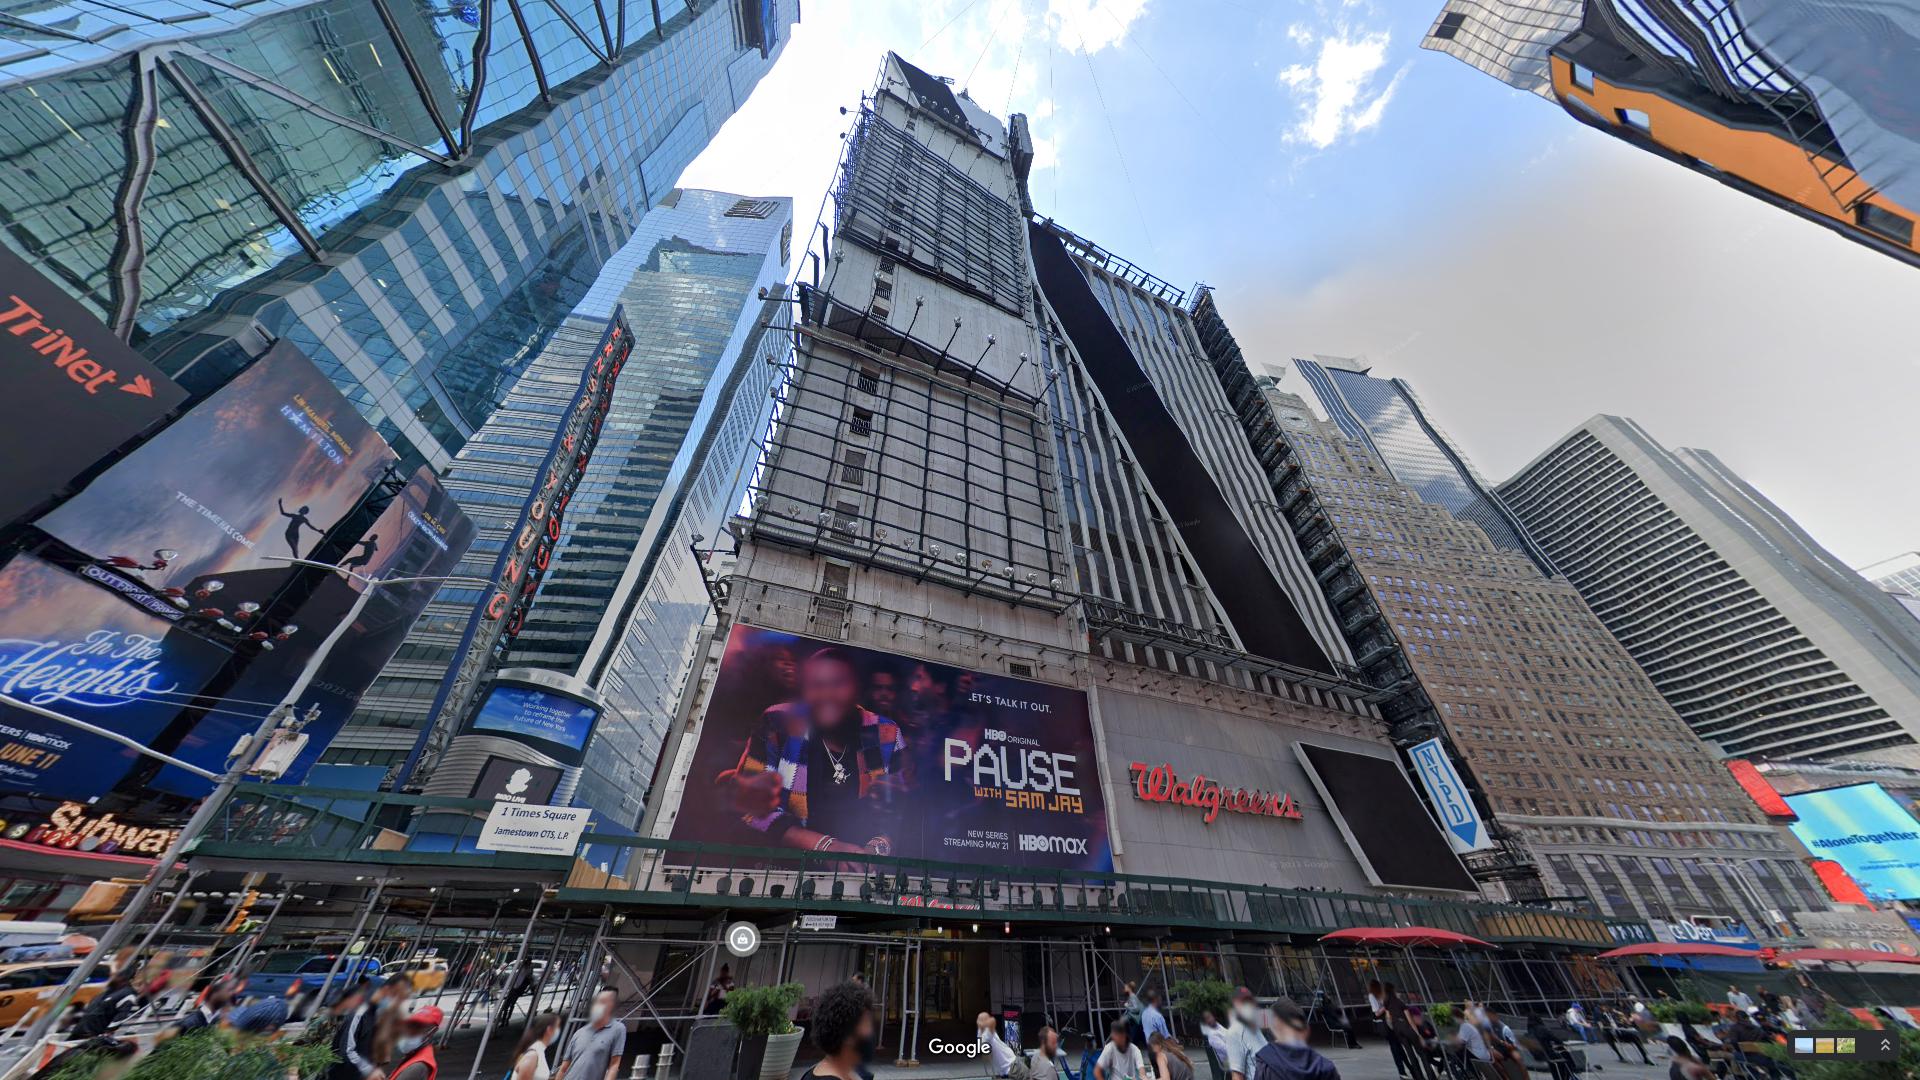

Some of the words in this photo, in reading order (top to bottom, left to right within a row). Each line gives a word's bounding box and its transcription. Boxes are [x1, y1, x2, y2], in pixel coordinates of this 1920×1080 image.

[0, 294, 117, 394] TriNet
[176, 491, 198, 509] THE
[196, 504, 222, 526] TIME
[218, 517, 234, 535] HAS
[231, 529, 256, 551] COME
[70, 629, 120, 656] In
[111, 633, 165, 660] The
[0, 638, 178, 707] Heights
[994, 696, 1019, 709] TALK
[1020, 701, 1028, 710] IT
[1031, 702, 1052, 714] OUT.
[984, 728, 1006, 741] HBO
[1007, 735, 1040, 747] ORIGINAL
[944, 737, 1081, 796] PAUSE
[1130, 761, 1303, 823] Walgreens
[1420, 748, 1465, 823] NYPD
[501, 806, 508, 816] 1
[510, 807, 541, 818] Times
[542, 809, 577, 821] Square
[974, 787, 1003, 799] WITH
[1005, 791, 1045, 811] SAM
[1048, 795, 1084, 814] JAY
[494, 827, 539, 838] Jamestown
[540, 829, 556, 840] OTS,
[557, 832, 569, 840] L.P.
[943, 837, 985, 848] STREAMING
[985, 840, 1001, 850] MAY
[1001, 841, 1009, 851] 21
[967, 830, 984, 838] NEW
[985, 831, 1008, 840] SERIES
[1811, 830, 1919, 849] #AloneTogether
